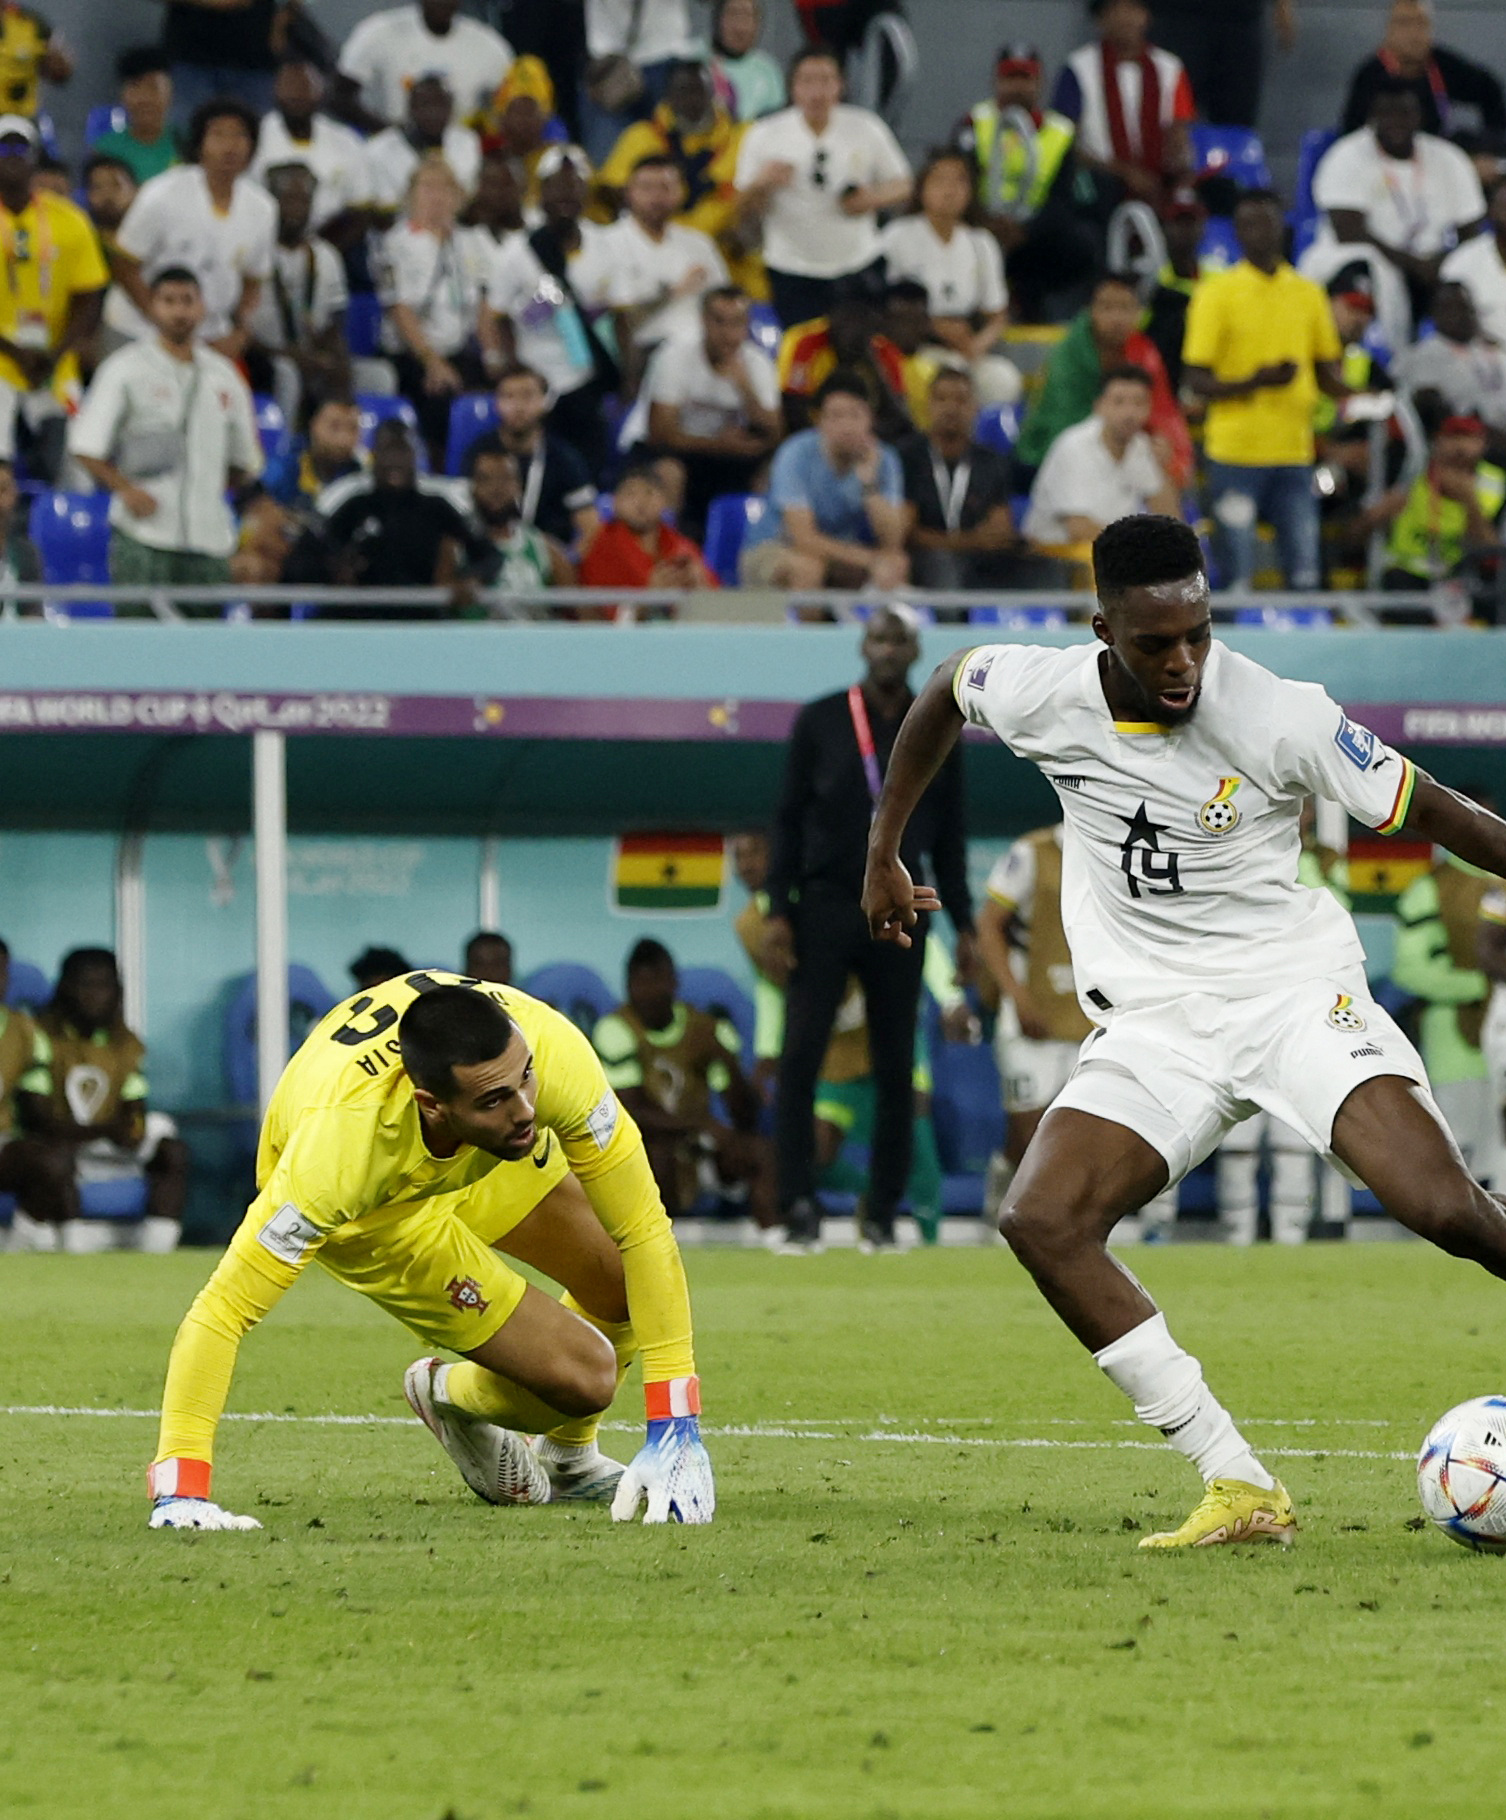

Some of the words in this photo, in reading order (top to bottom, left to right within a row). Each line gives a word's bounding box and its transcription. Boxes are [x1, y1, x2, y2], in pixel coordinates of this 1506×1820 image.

[0, 694, 34, 727] A
[35, 694, 134, 727] WORLD
[135, 694, 188, 728] CUP
[313, 694, 390, 728] 2022
[1403, 709, 1461, 740] FIFA
[1120, 843, 1185, 898] 19
